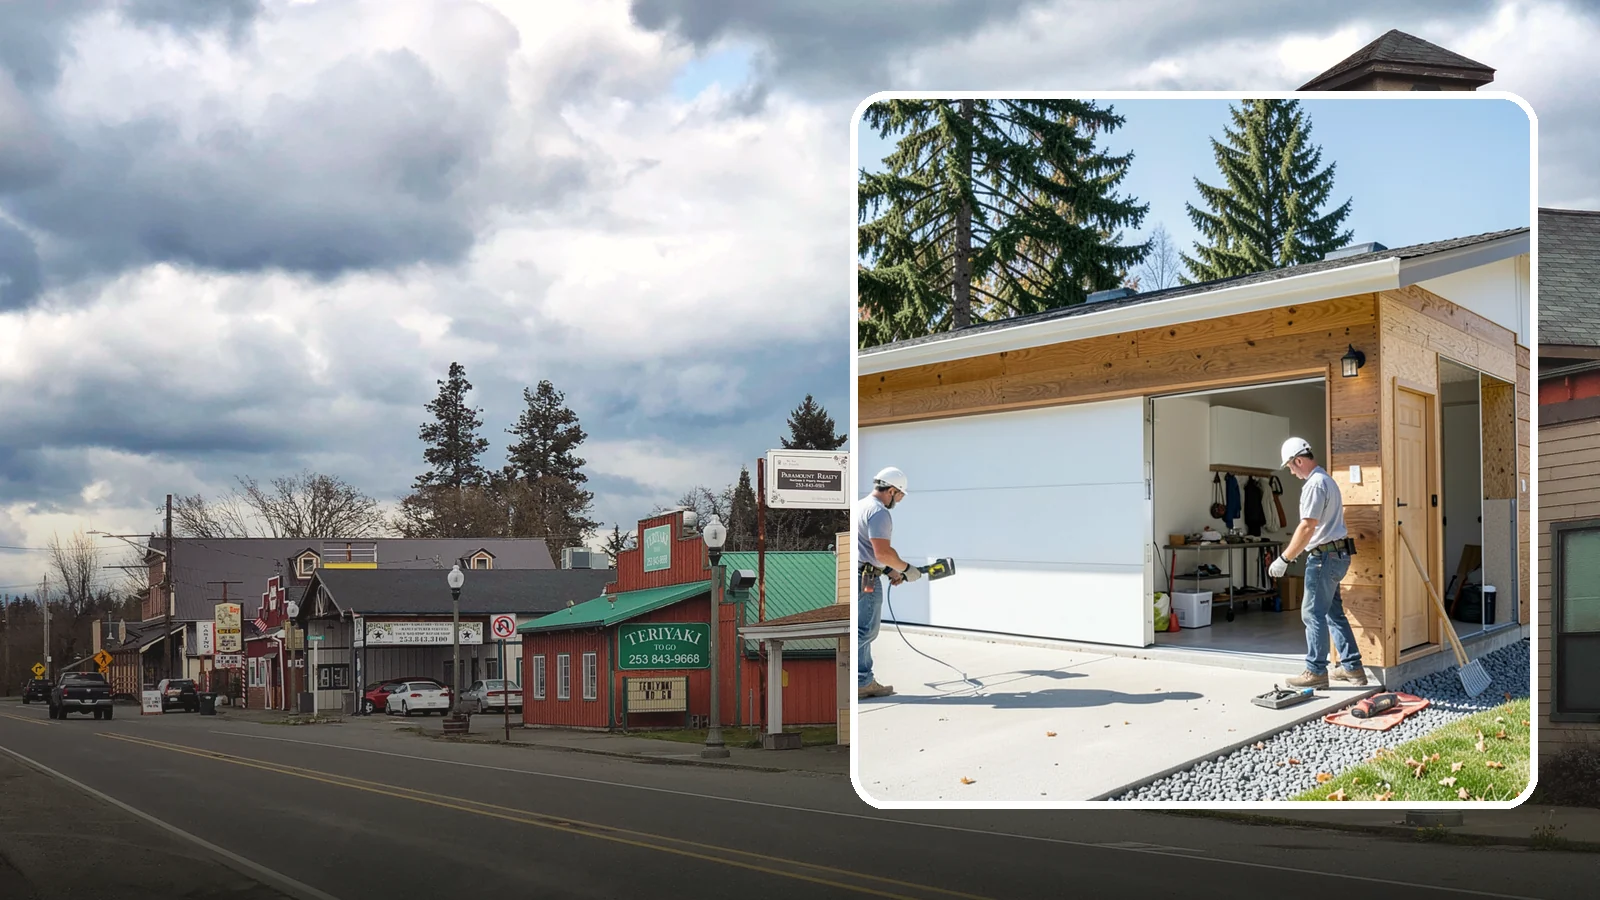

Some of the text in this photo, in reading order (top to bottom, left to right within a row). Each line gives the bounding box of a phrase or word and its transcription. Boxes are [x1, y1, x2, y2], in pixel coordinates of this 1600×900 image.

[781, 471, 838, 480] PARAMOUNT REALTY
[624, 628, 702, 646] TERIYAKI
[628, 654, 700, 664] 253 843-9668
[639, 681, 672, 690] TERIYAKI
